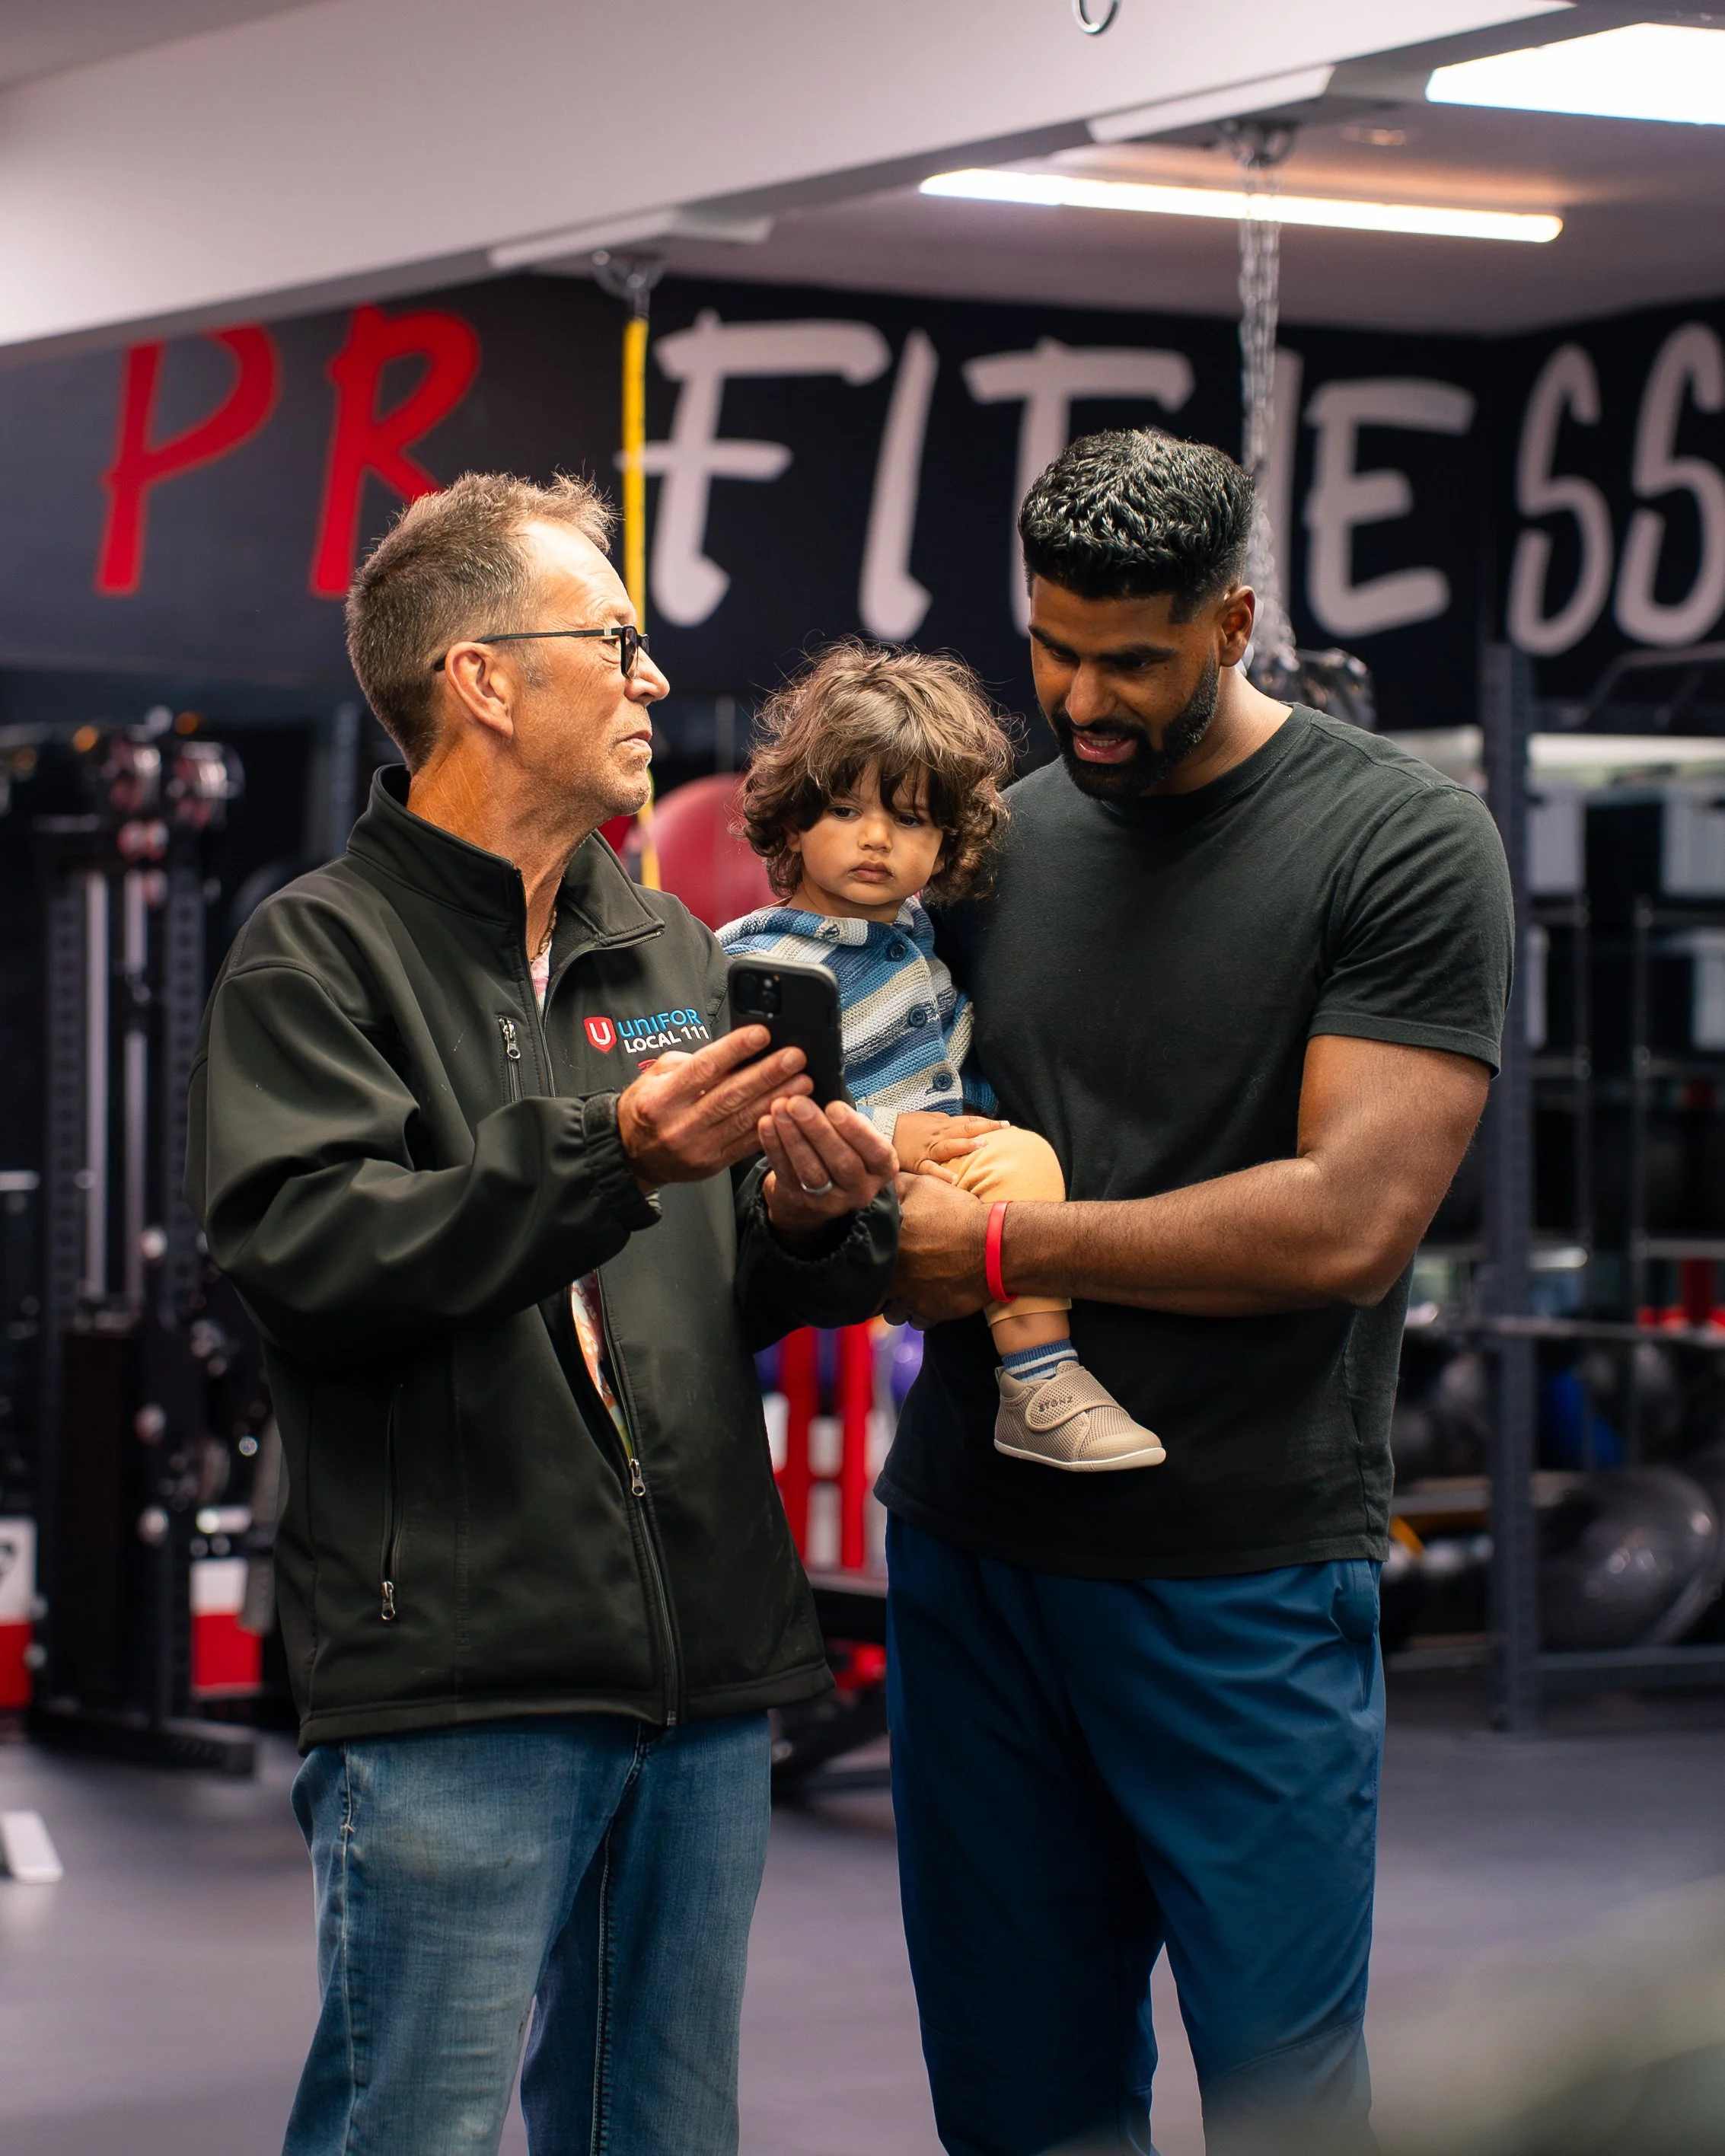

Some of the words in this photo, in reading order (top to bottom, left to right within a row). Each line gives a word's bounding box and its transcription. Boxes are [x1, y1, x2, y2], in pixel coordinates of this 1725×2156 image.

[96, 300, 481, 598] PR
[612, 307, 1725, 659] FITESS
[623, 1030, 682, 1054] LOCAL
[681, 1025, 709, 1040] 111
